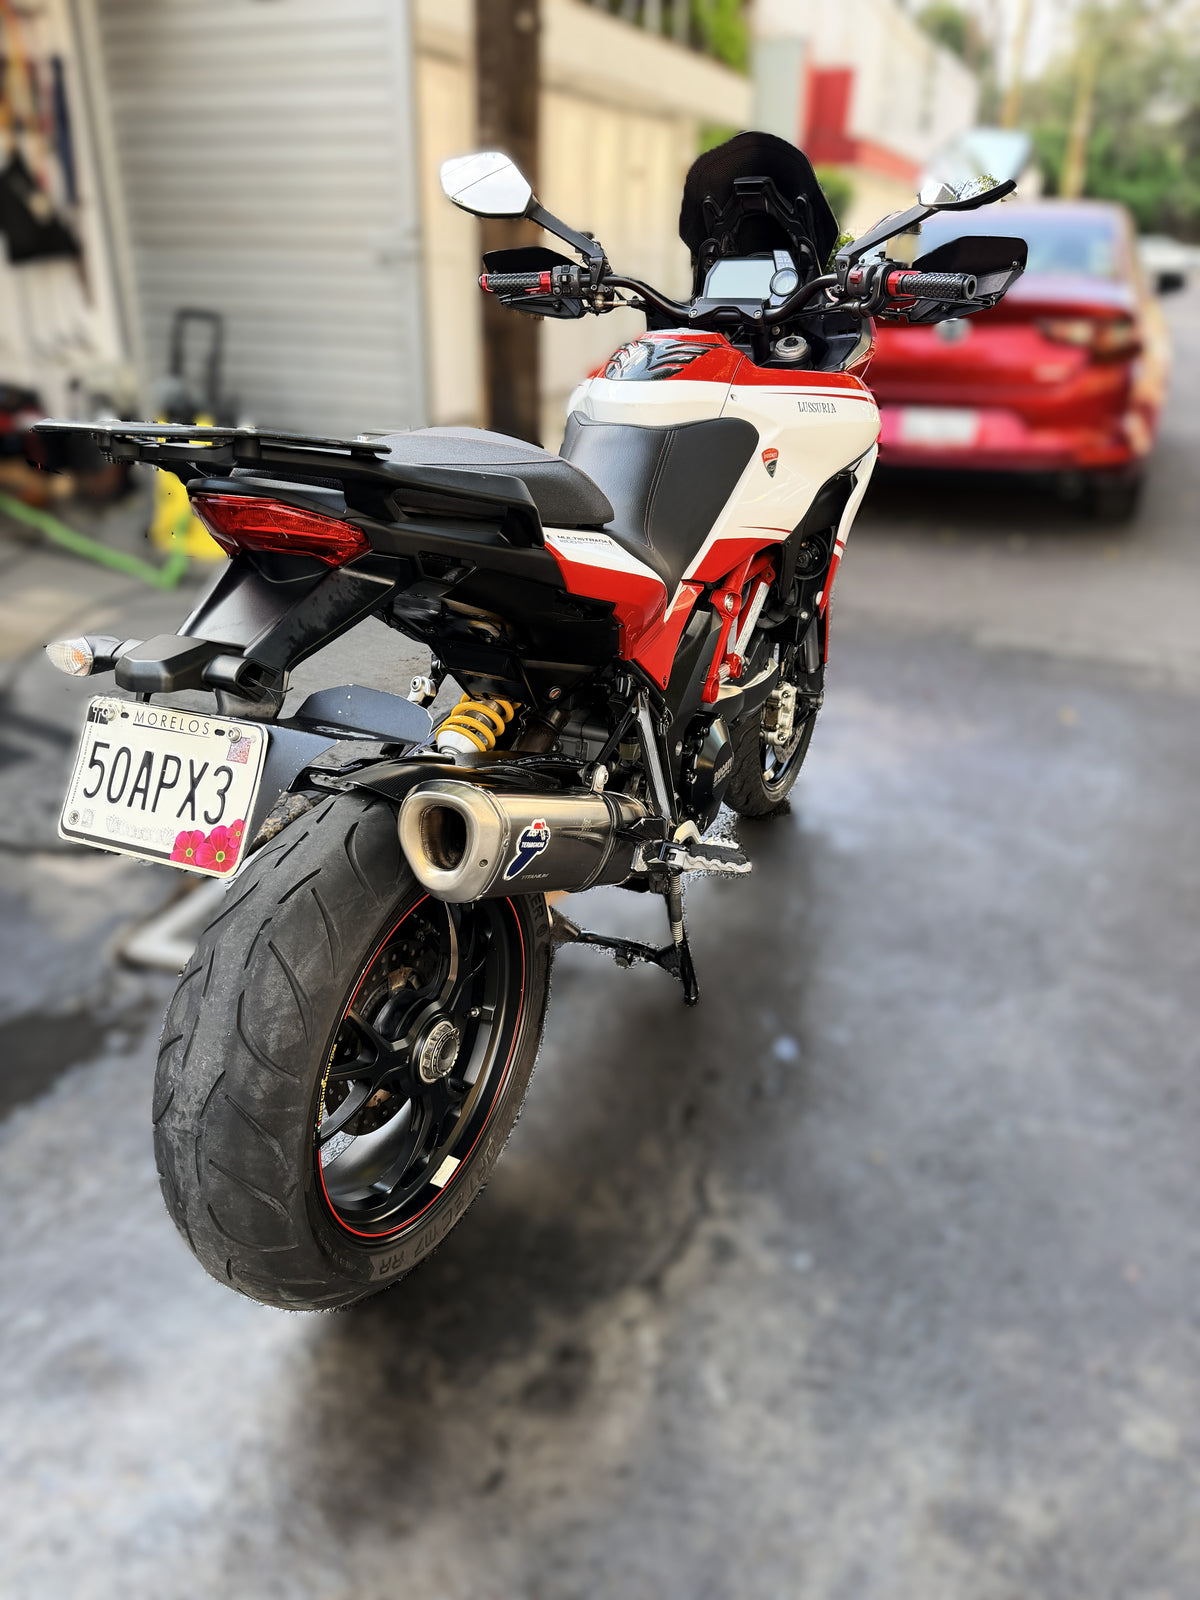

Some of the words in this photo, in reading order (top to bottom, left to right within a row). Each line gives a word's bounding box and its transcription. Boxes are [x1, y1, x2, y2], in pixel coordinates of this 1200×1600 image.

[797, 401, 837, 414] LUSSURIA
[133, 710, 211, 736] MORELOS
[83, 740, 234, 826] 50APX3
